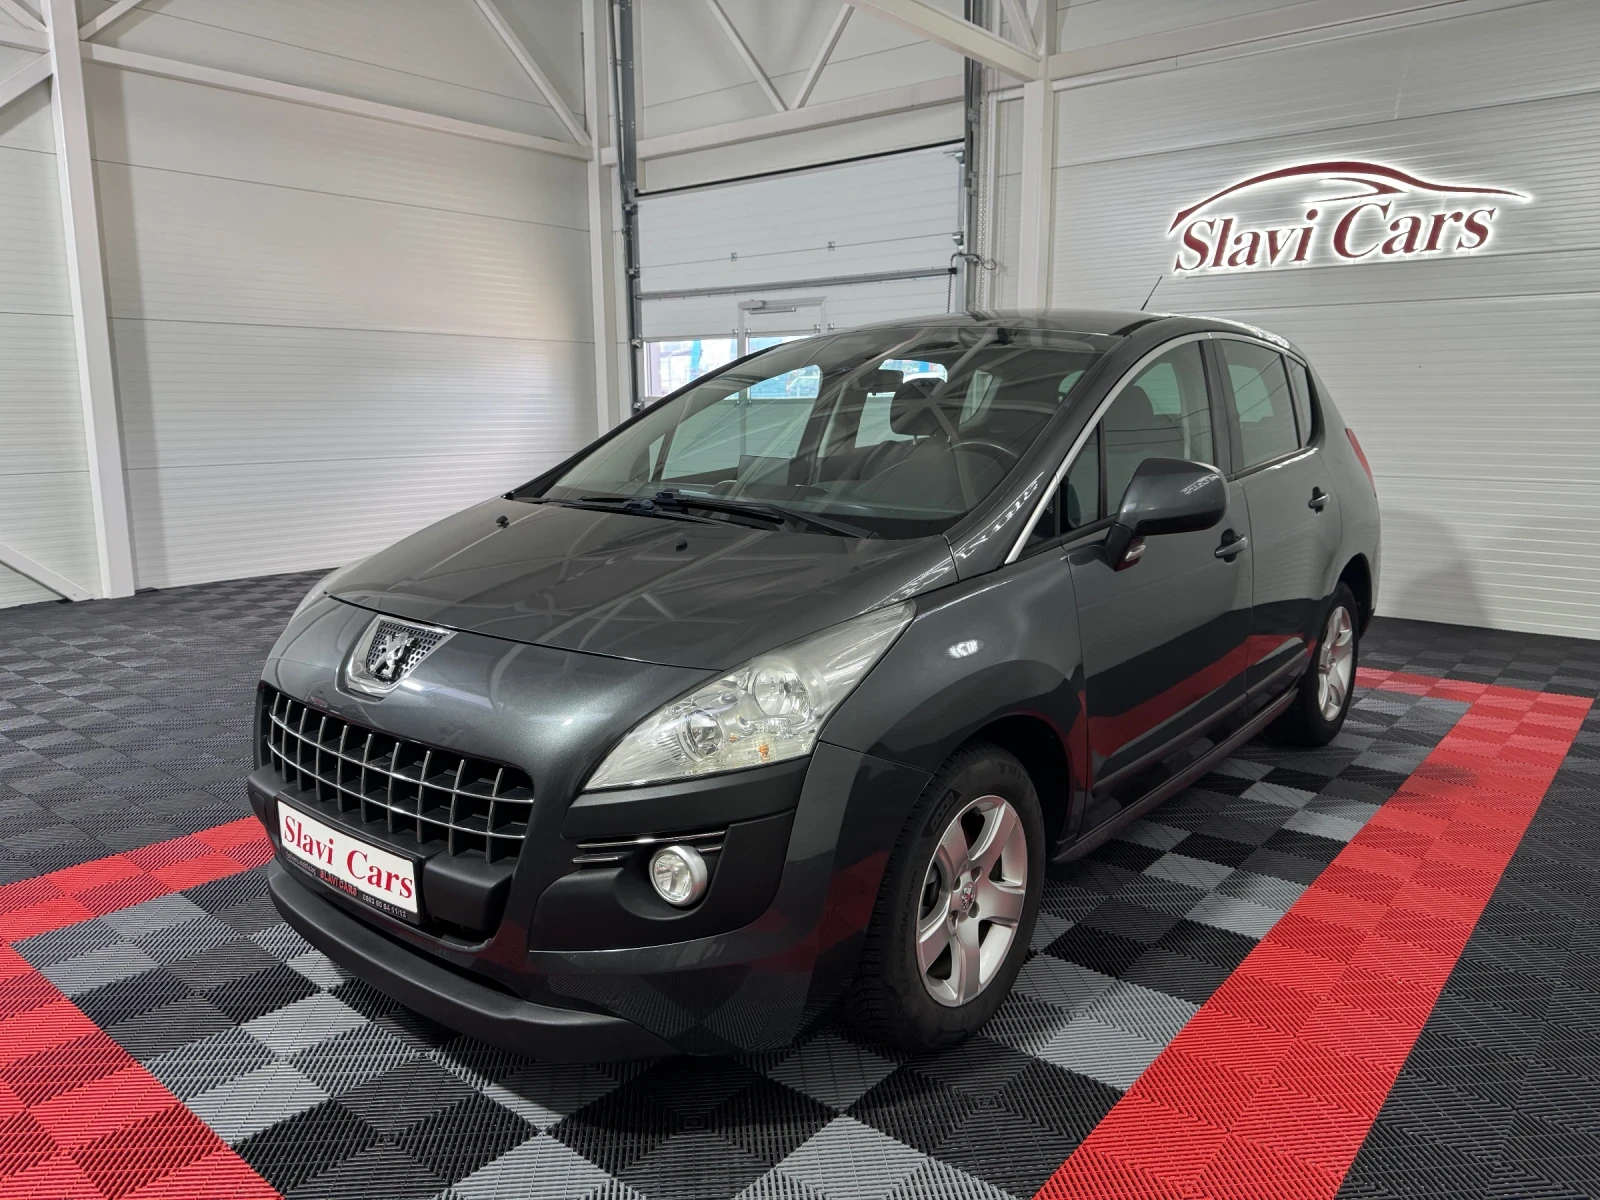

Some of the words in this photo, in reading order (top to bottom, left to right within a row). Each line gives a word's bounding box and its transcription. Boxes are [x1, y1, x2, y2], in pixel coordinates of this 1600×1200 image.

[1174, 208, 1319, 272] Slavi
[1333, 200, 1497, 259] Cars
[284, 815, 334, 866] Slavi
[346, 849, 413, 899] Cars
[320, 870, 338, 887] SLAVI
[339, 880, 357, 897] CARS
